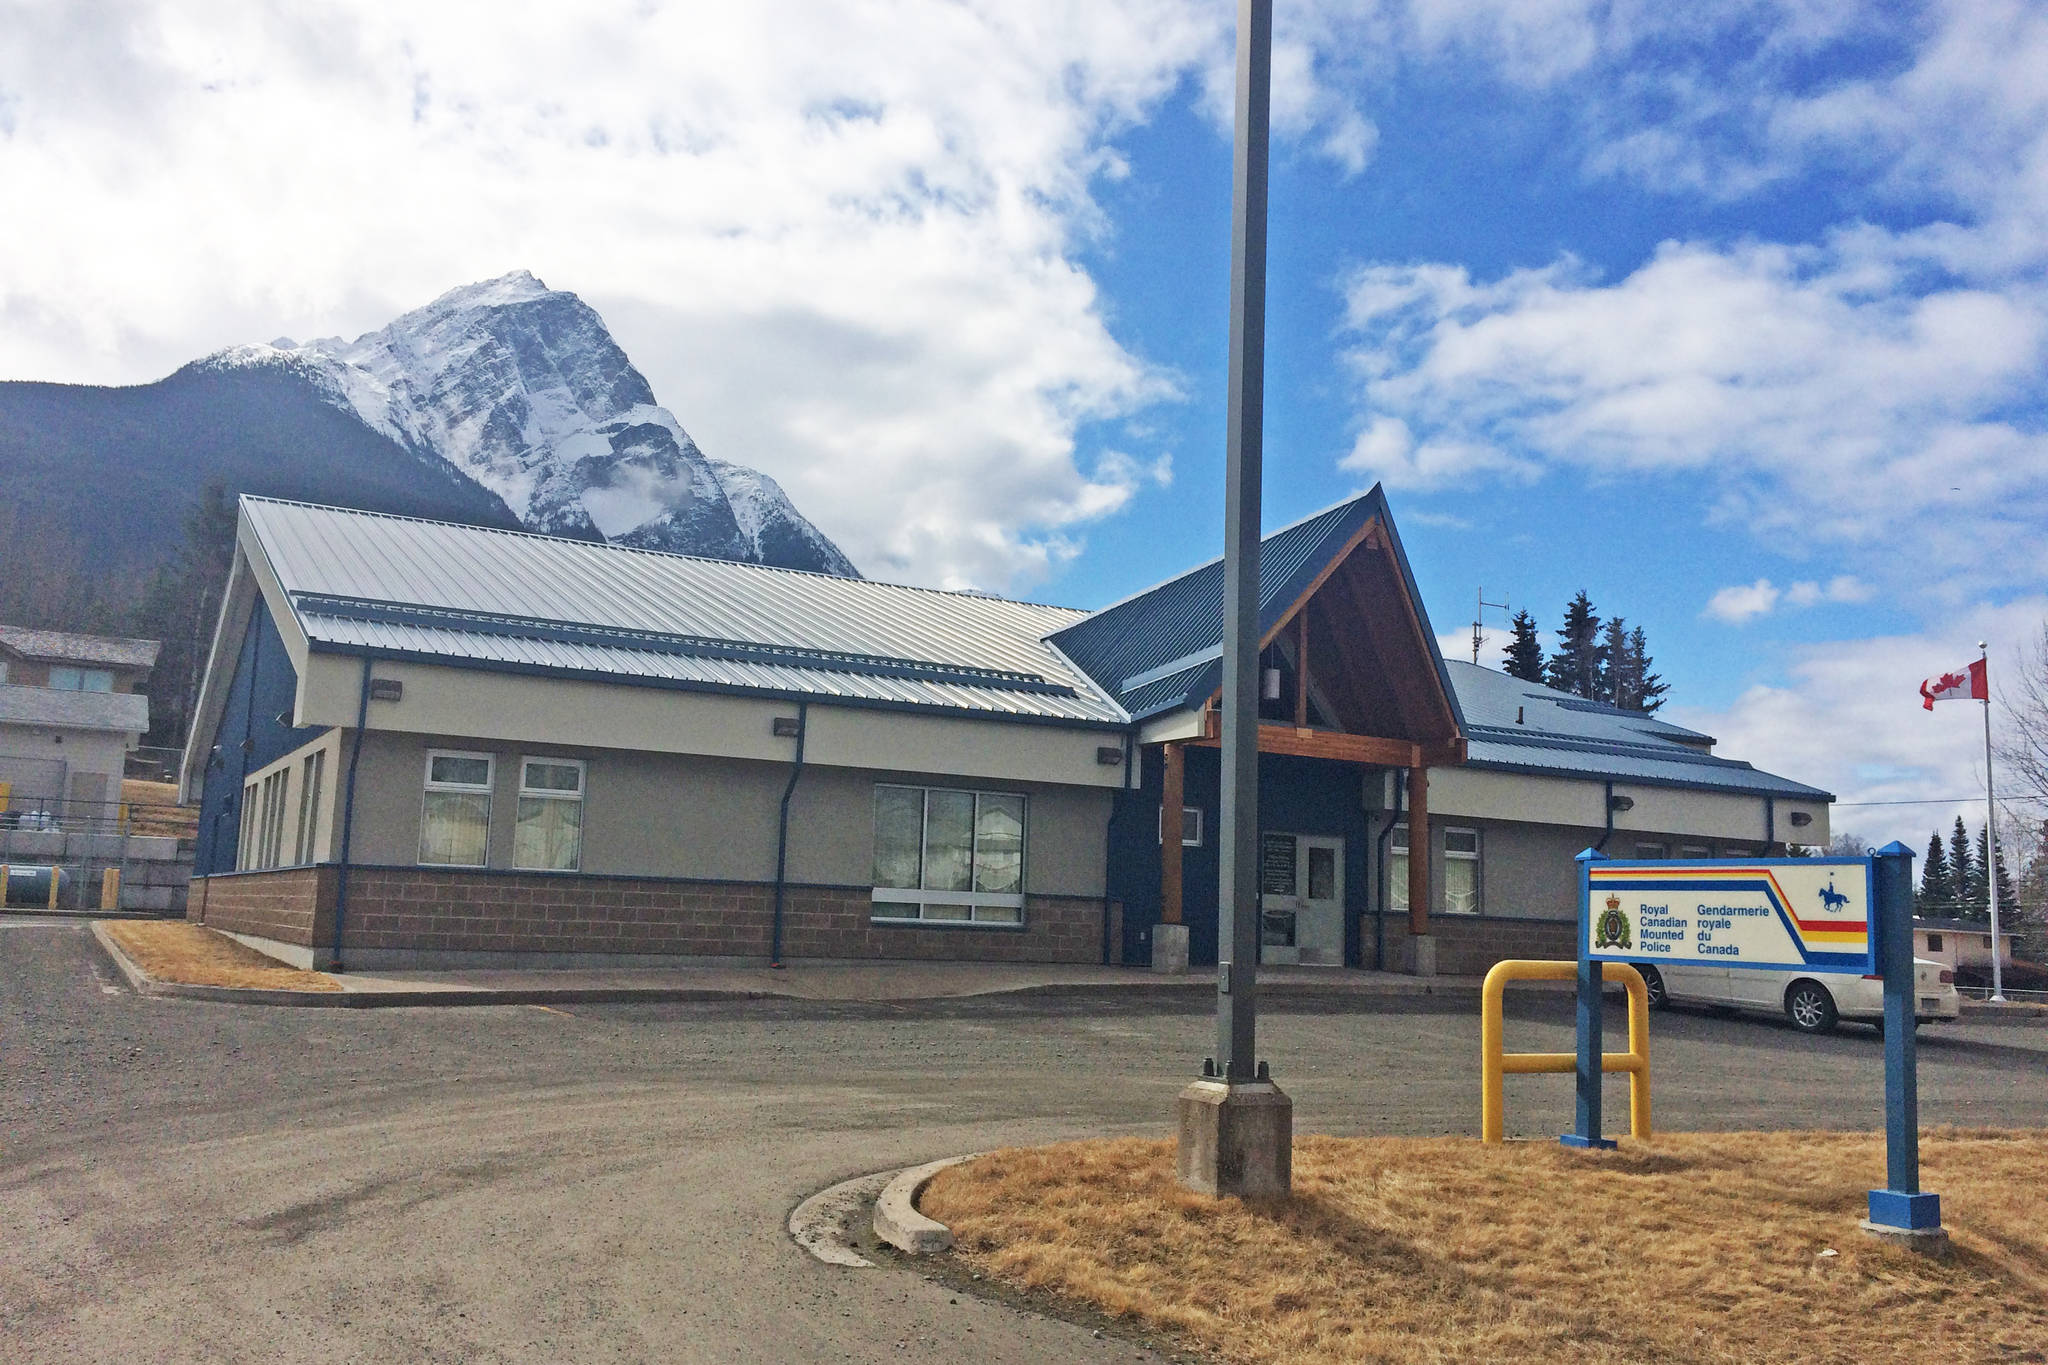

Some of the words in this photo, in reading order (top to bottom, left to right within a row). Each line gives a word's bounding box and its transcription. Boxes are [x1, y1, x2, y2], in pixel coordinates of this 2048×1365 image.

[1640, 904, 1668, 917] Royal
[1697, 904, 1769, 917] Gendarmerie
[1640, 916, 1687, 928] Canadian
[1697, 917, 1731, 931] royale
[1640, 929, 1684, 940] Mounted
[1697, 930, 1711, 941] du
[1640, 941, 1671, 952] Police
[1697, 943, 1739, 955] Canada
